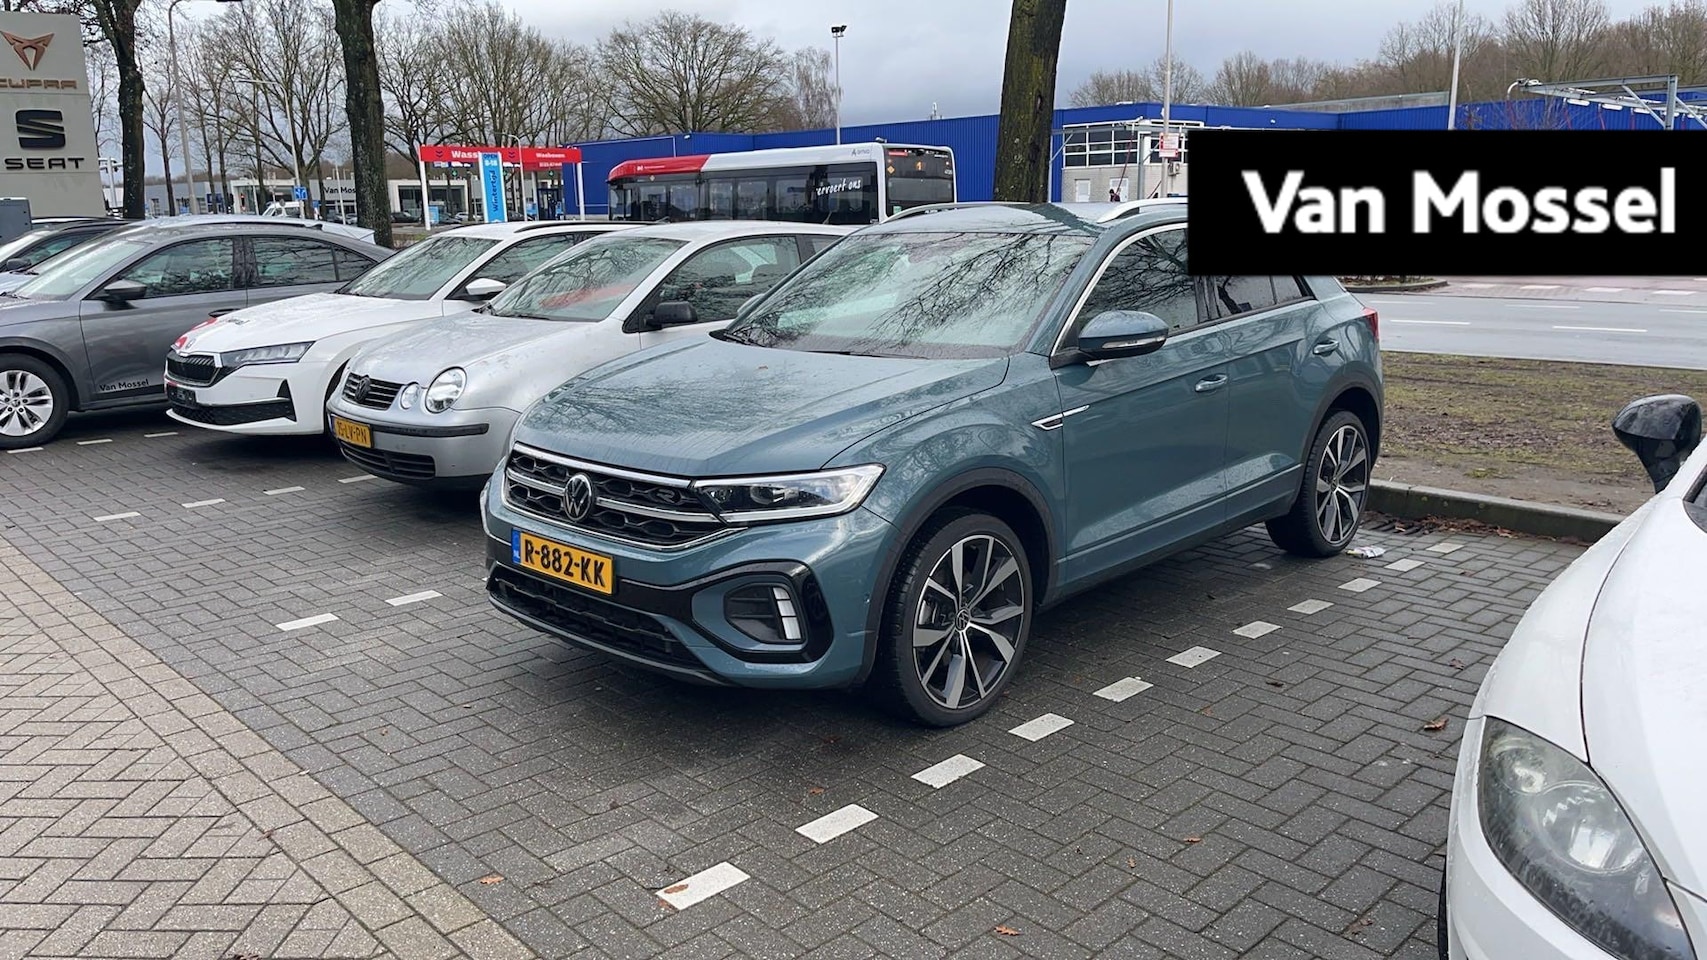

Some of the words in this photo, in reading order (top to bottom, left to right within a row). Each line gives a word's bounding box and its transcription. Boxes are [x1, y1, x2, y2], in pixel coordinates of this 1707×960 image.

[451, 151, 479, 159] Wass
[4, 157, 85, 170] SEAT
[118, 378, 149, 389] Mossel
[524, 538, 606, 588] R-882-KK
